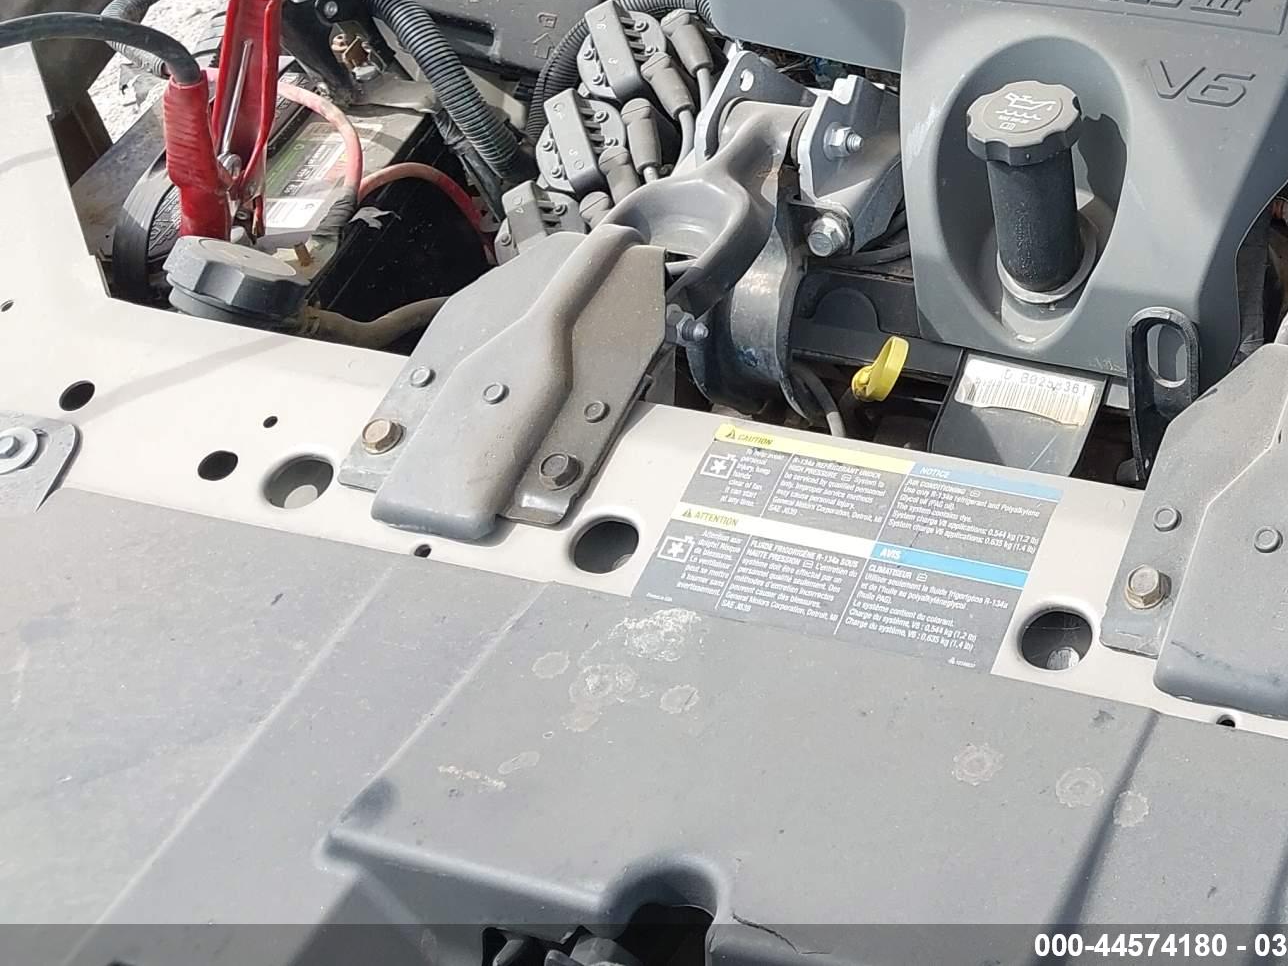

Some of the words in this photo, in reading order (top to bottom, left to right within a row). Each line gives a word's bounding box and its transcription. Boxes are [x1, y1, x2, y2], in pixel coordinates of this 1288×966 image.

[1146, 60, 1256, 108] V6
[737, 433, 774, 446] CAUTION
[919, 466, 950, 479] NOTICE
[771, 496, 796, 506] General
[789, 491, 809, 500] cause
[808, 494, 836, 506] personal
[692, 510, 738, 527] ATTENTION
[890, 509, 916, 522] System
[915, 514, 939, 526] charge
[887, 518, 912, 530] System
[911, 524, 935, 534] charge
[745, 548, 769, 559] HAUTE
[767, 552, 801, 565] PRESSION
[879, 547, 902, 559] AVIS
[768, 562, 782, 571] doit
[839, 557, 859, 568] SOUS
[737, 565, 769, 578] personnel
[708, 578, 724, 587] sans
[724, 591, 749, 602] General
[748, 595, 771, 606] Motors
[847, 607, 873, 620] Charge
[843, 616, 869, 629] Charge
